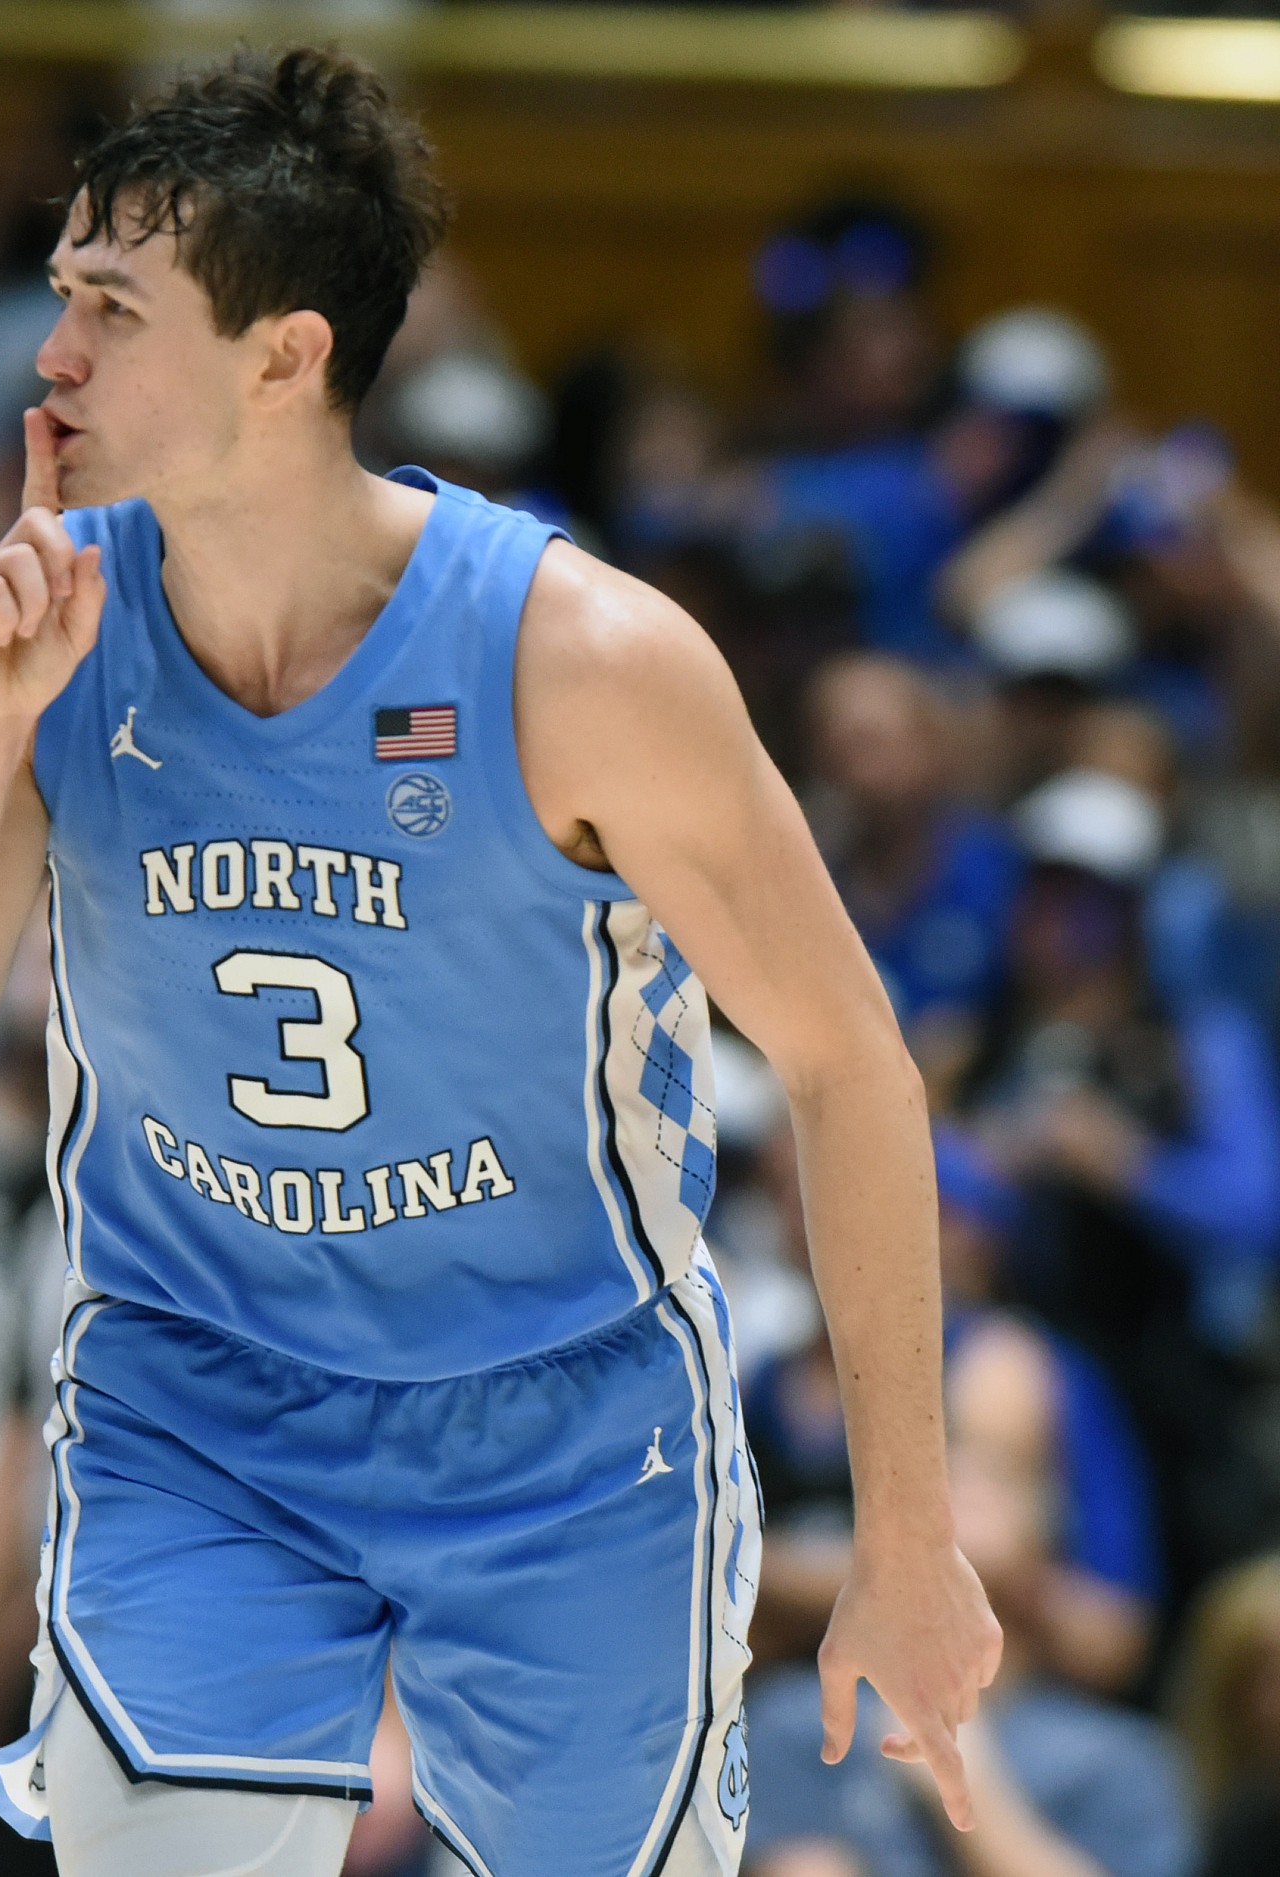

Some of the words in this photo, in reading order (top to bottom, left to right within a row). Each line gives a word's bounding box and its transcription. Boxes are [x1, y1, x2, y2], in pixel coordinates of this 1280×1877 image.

[140, 839, 408, 931] NORTH
[211, 949, 371, 1133] 3
[141, 1113, 516, 1236] CAROLINA
